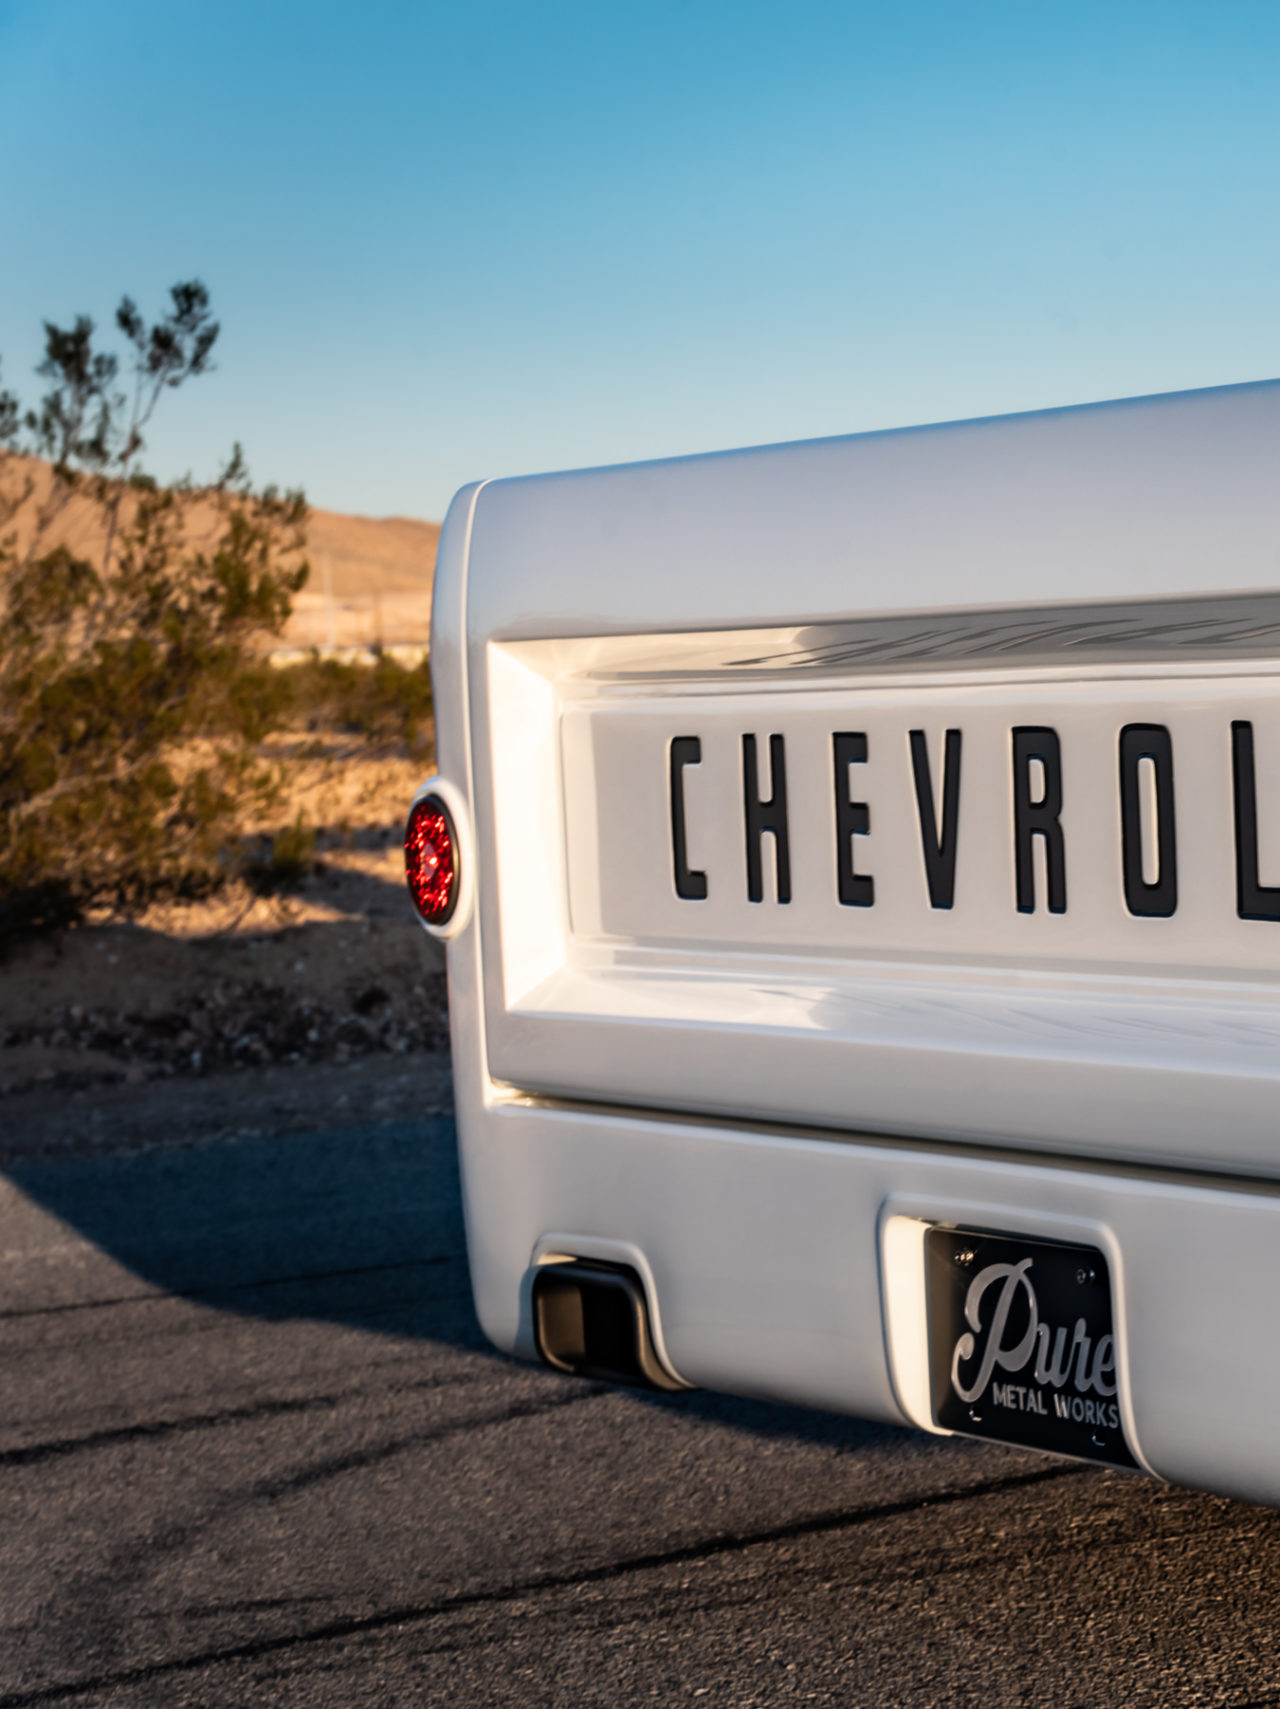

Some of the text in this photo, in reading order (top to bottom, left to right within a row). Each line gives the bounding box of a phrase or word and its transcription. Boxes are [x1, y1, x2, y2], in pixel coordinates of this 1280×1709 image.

[951, 1257, 1119, 1402] Pure
[992, 1381, 1120, 1429] METAL WORKS
